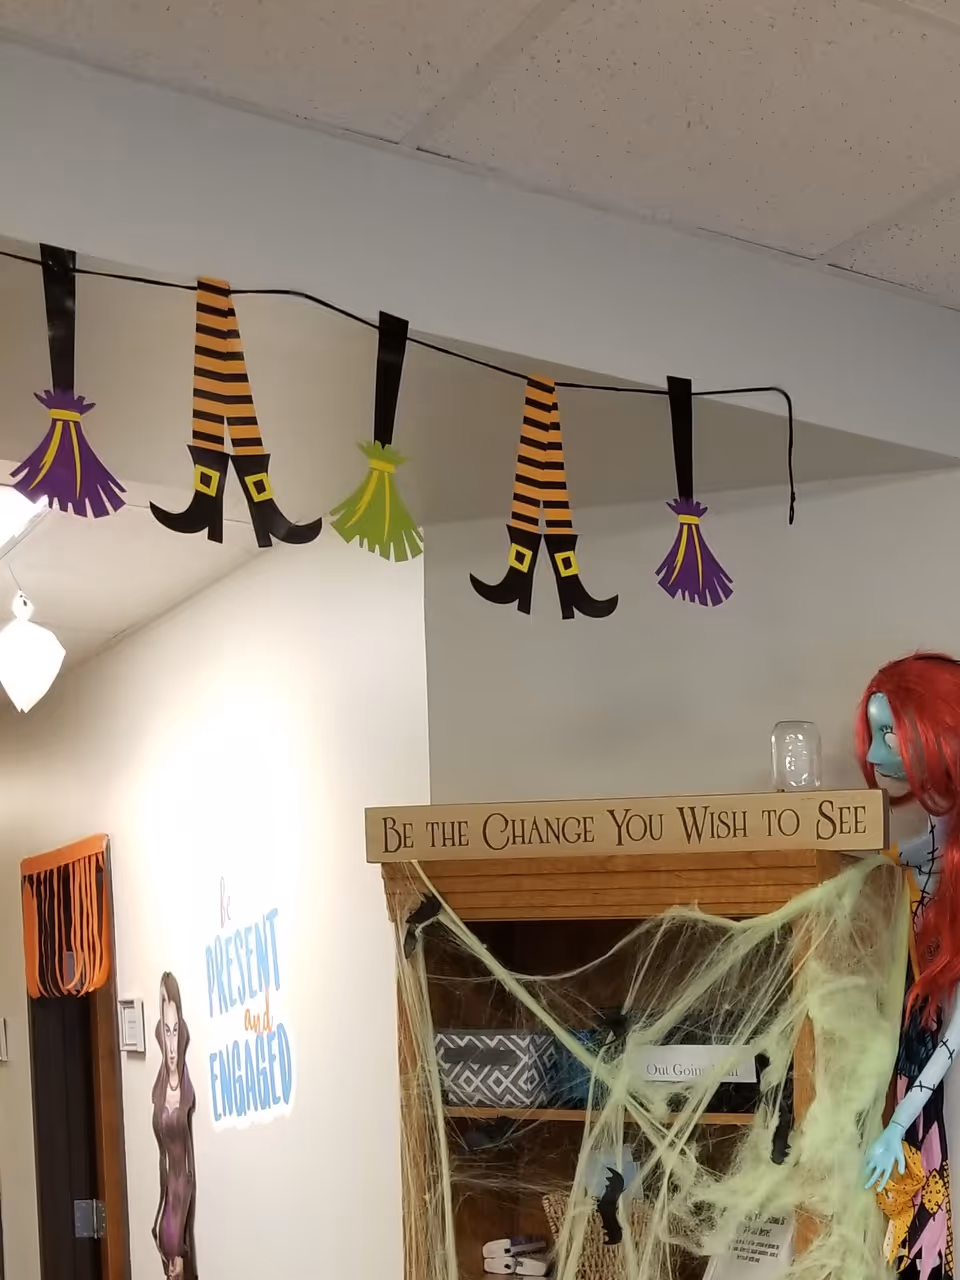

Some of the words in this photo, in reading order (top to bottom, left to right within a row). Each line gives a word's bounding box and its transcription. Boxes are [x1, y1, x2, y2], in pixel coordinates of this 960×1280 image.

[425, 819, 469, 848] THE
[482, 812, 596, 852] CHANGE
[606, 807, 665, 847] YOU
[676, 806, 750, 845] WISH
[761, 808, 801, 838] TO
[816, 799, 867, 841] SEE
[205, 908, 280, 1018] PRESENT
[244, 987, 273, 1034] and
[209, 1023, 292, 1122] ENGAGED
[646, 1063, 668, 1076] Out
[673, 1063, 703, 1077] Goin
